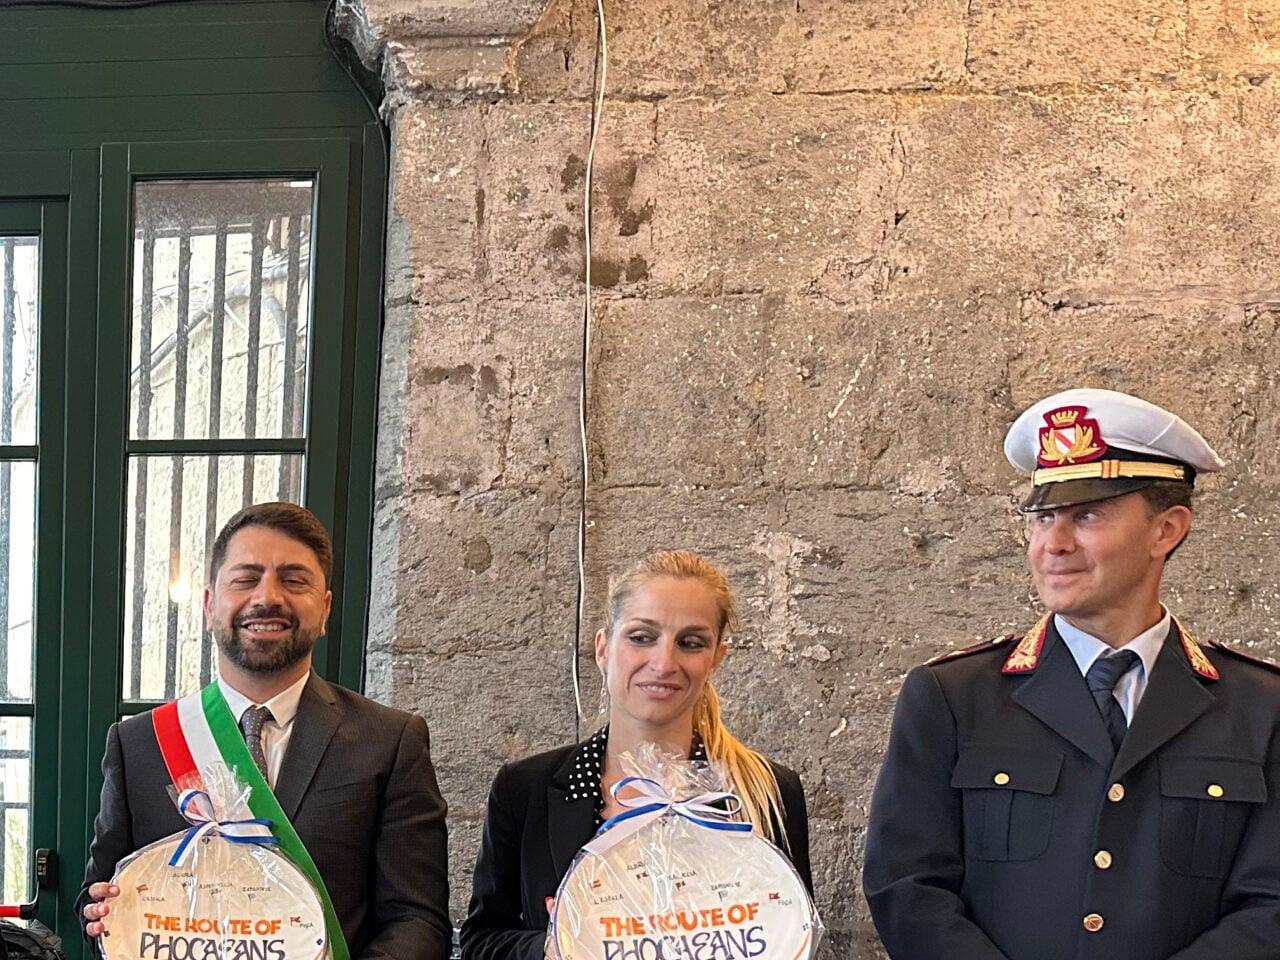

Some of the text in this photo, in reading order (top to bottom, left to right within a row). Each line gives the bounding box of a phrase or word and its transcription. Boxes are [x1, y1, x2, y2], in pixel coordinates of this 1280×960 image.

[143, 913, 282, 936] THE ROUTE OF
[599, 902, 760, 938] THE ROUTE OF
